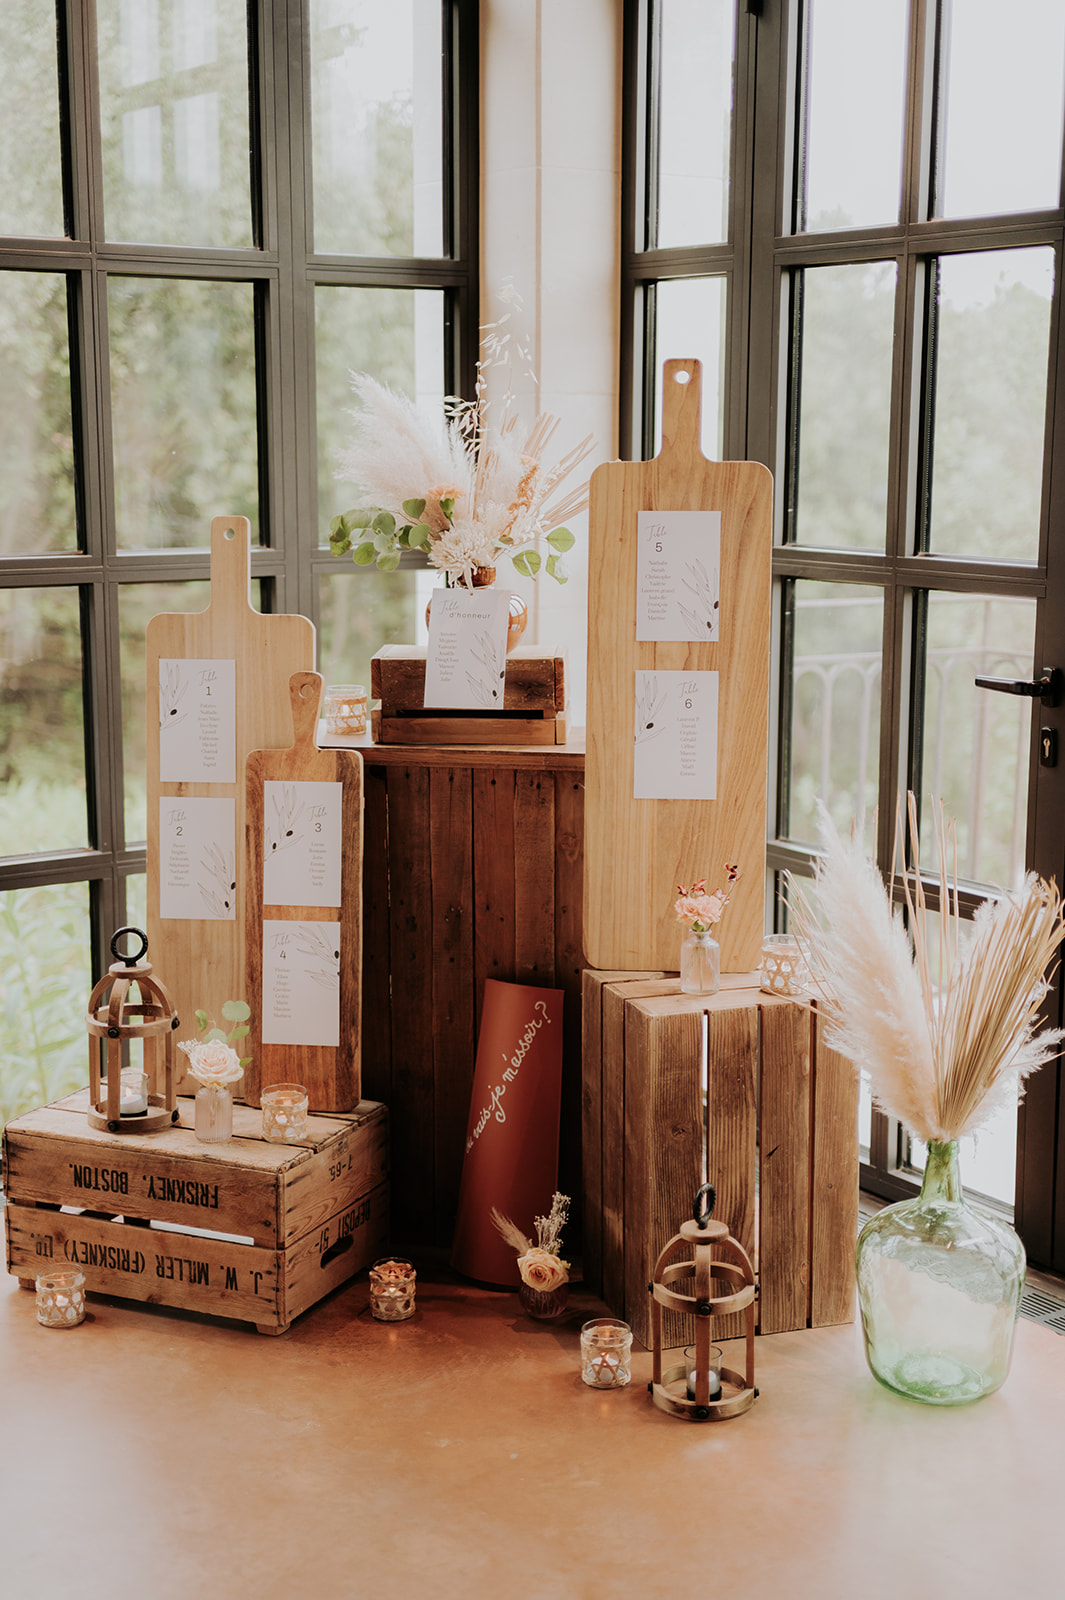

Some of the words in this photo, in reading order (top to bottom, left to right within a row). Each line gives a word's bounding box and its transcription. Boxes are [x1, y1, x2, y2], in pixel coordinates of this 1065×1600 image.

[646, 524, 666, 542] Table
[655, 542, 663, 552] 5
[199, 669, 217, 686] Table
[206, 686, 212, 696] 1
[679, 681, 698, 698] Table
[685, 698, 692, 709] 6
[168, 809, 187, 826] Table
[307, 804, 327, 822] Table
[176, 826, 183, 836] 2
[315, 823, 322, 832] 3
[270, 933, 290, 950] Table
[280, 950, 286, 959] 4
[534, 1001, 552, 1024] ?
[64, 1239, 146, 1274] (FRISKNEY)
[156, 1254, 209, 1286] MILLER
[220, 1265, 238, 1292] W.
